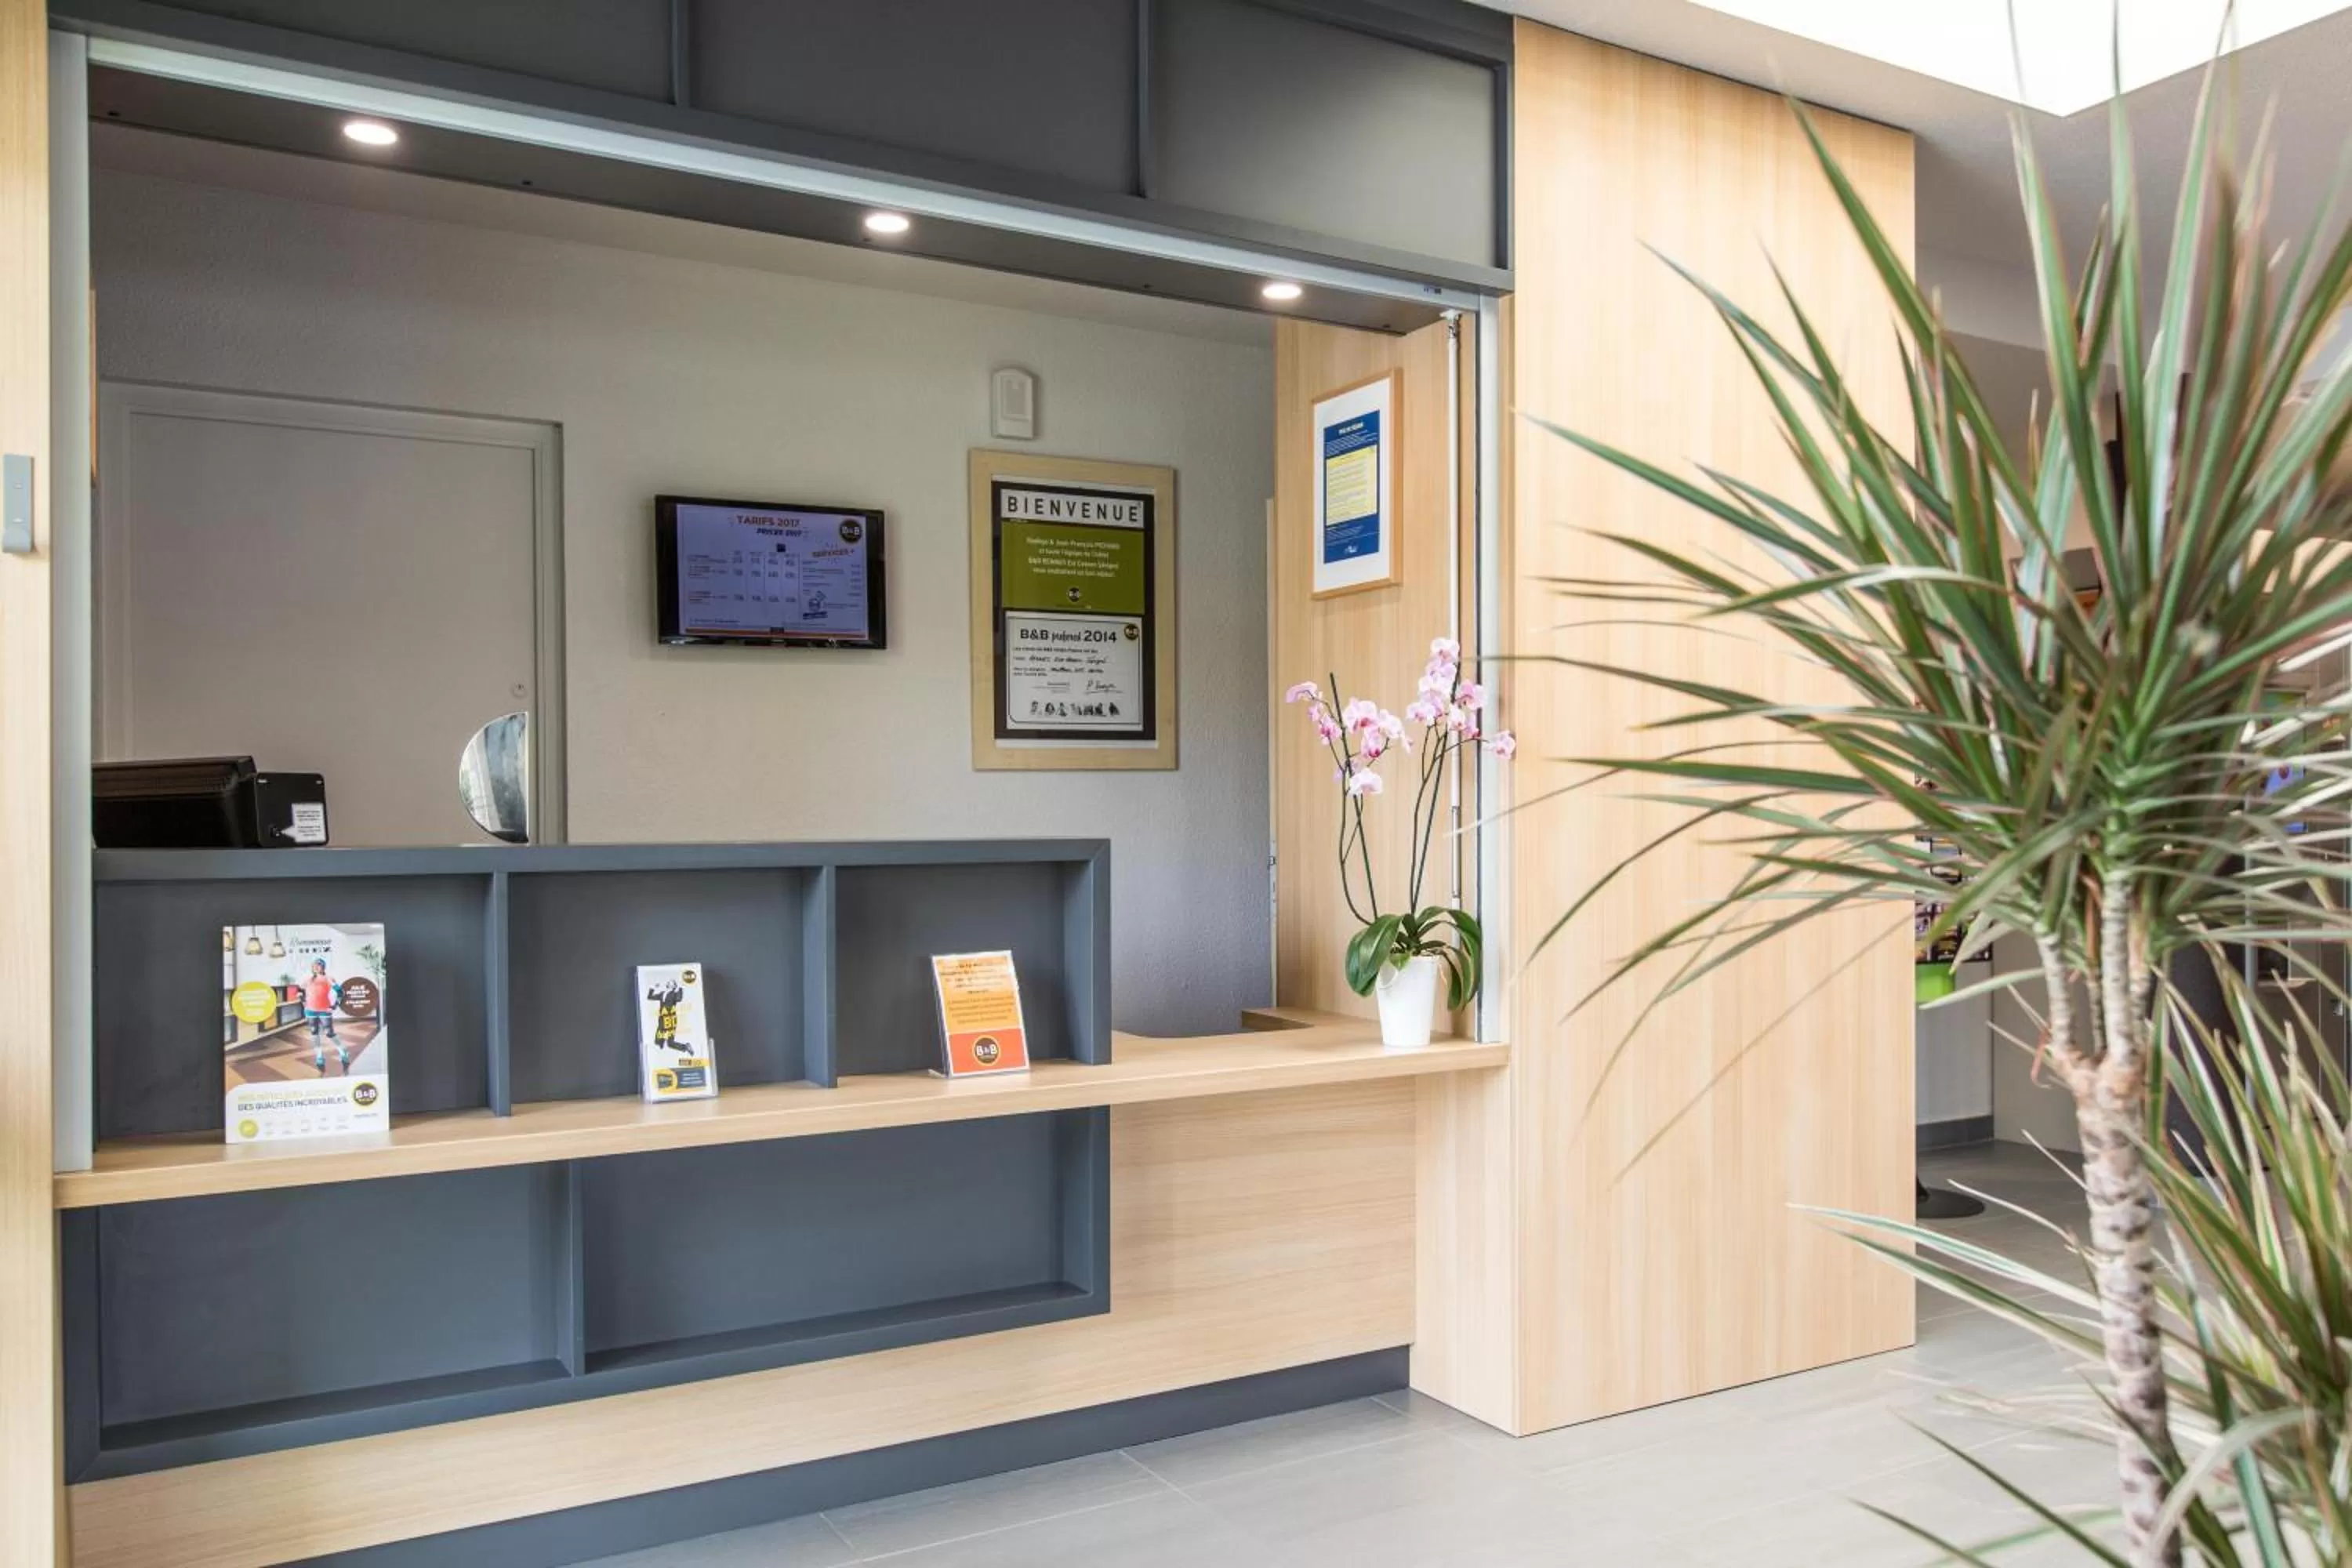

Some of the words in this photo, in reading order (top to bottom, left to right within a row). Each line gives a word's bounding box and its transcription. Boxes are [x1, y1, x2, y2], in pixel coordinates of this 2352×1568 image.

[1007, 495, 1138, 522] BIENVENUE
[737, 515, 775, 526] TARIFS
[777, 517, 800, 528] 2017
[1020, 628, 1049, 641] B&B
[1083, 630, 1117, 643] 2014
[976, 1044, 998, 1056] B&B
[355, 1089, 376, 1099] B&B
[238, 1102, 254, 1112] DES
